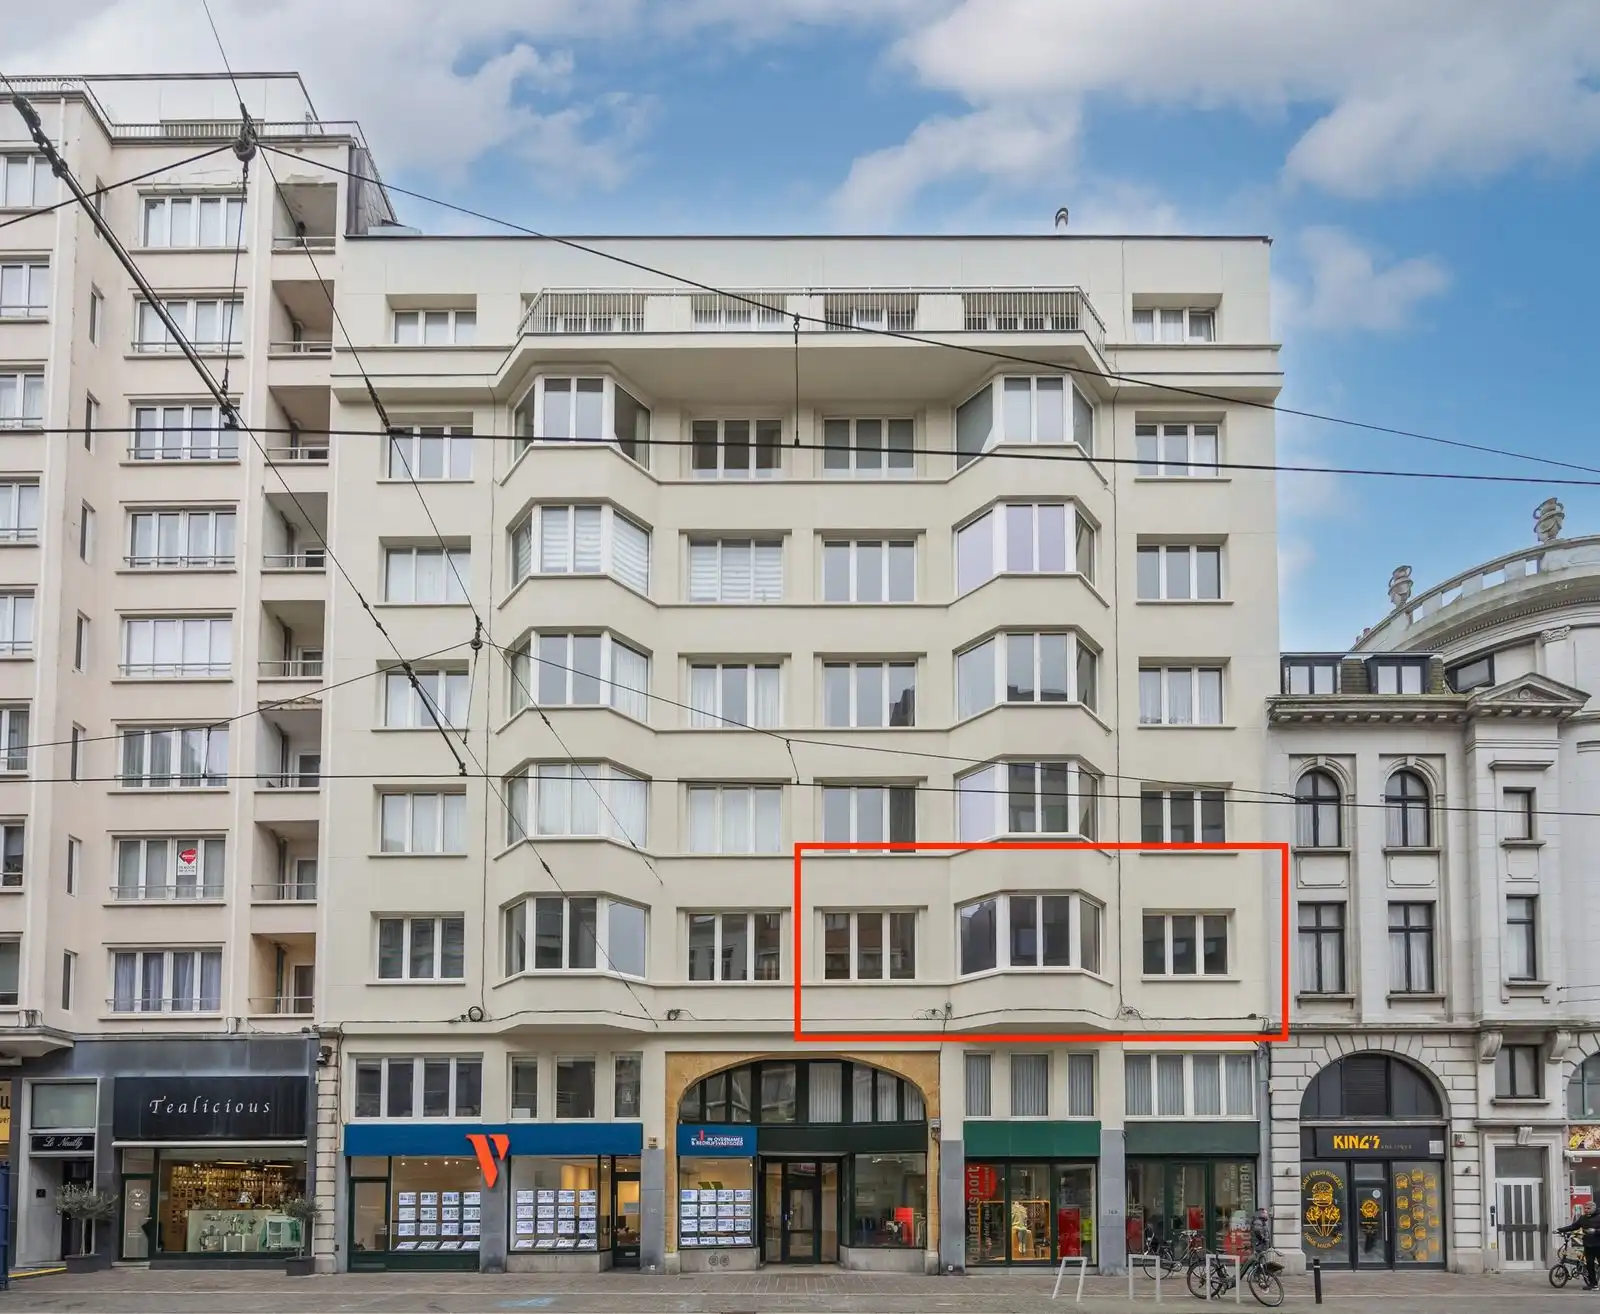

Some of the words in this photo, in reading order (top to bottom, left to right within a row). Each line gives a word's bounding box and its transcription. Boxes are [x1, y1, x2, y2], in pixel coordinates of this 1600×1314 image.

[149, 1096, 270, 1114] Tealicious
[1333, 1135, 1380, 1149] KING'S
[1310, 1169, 1326, 1178] FRESH
